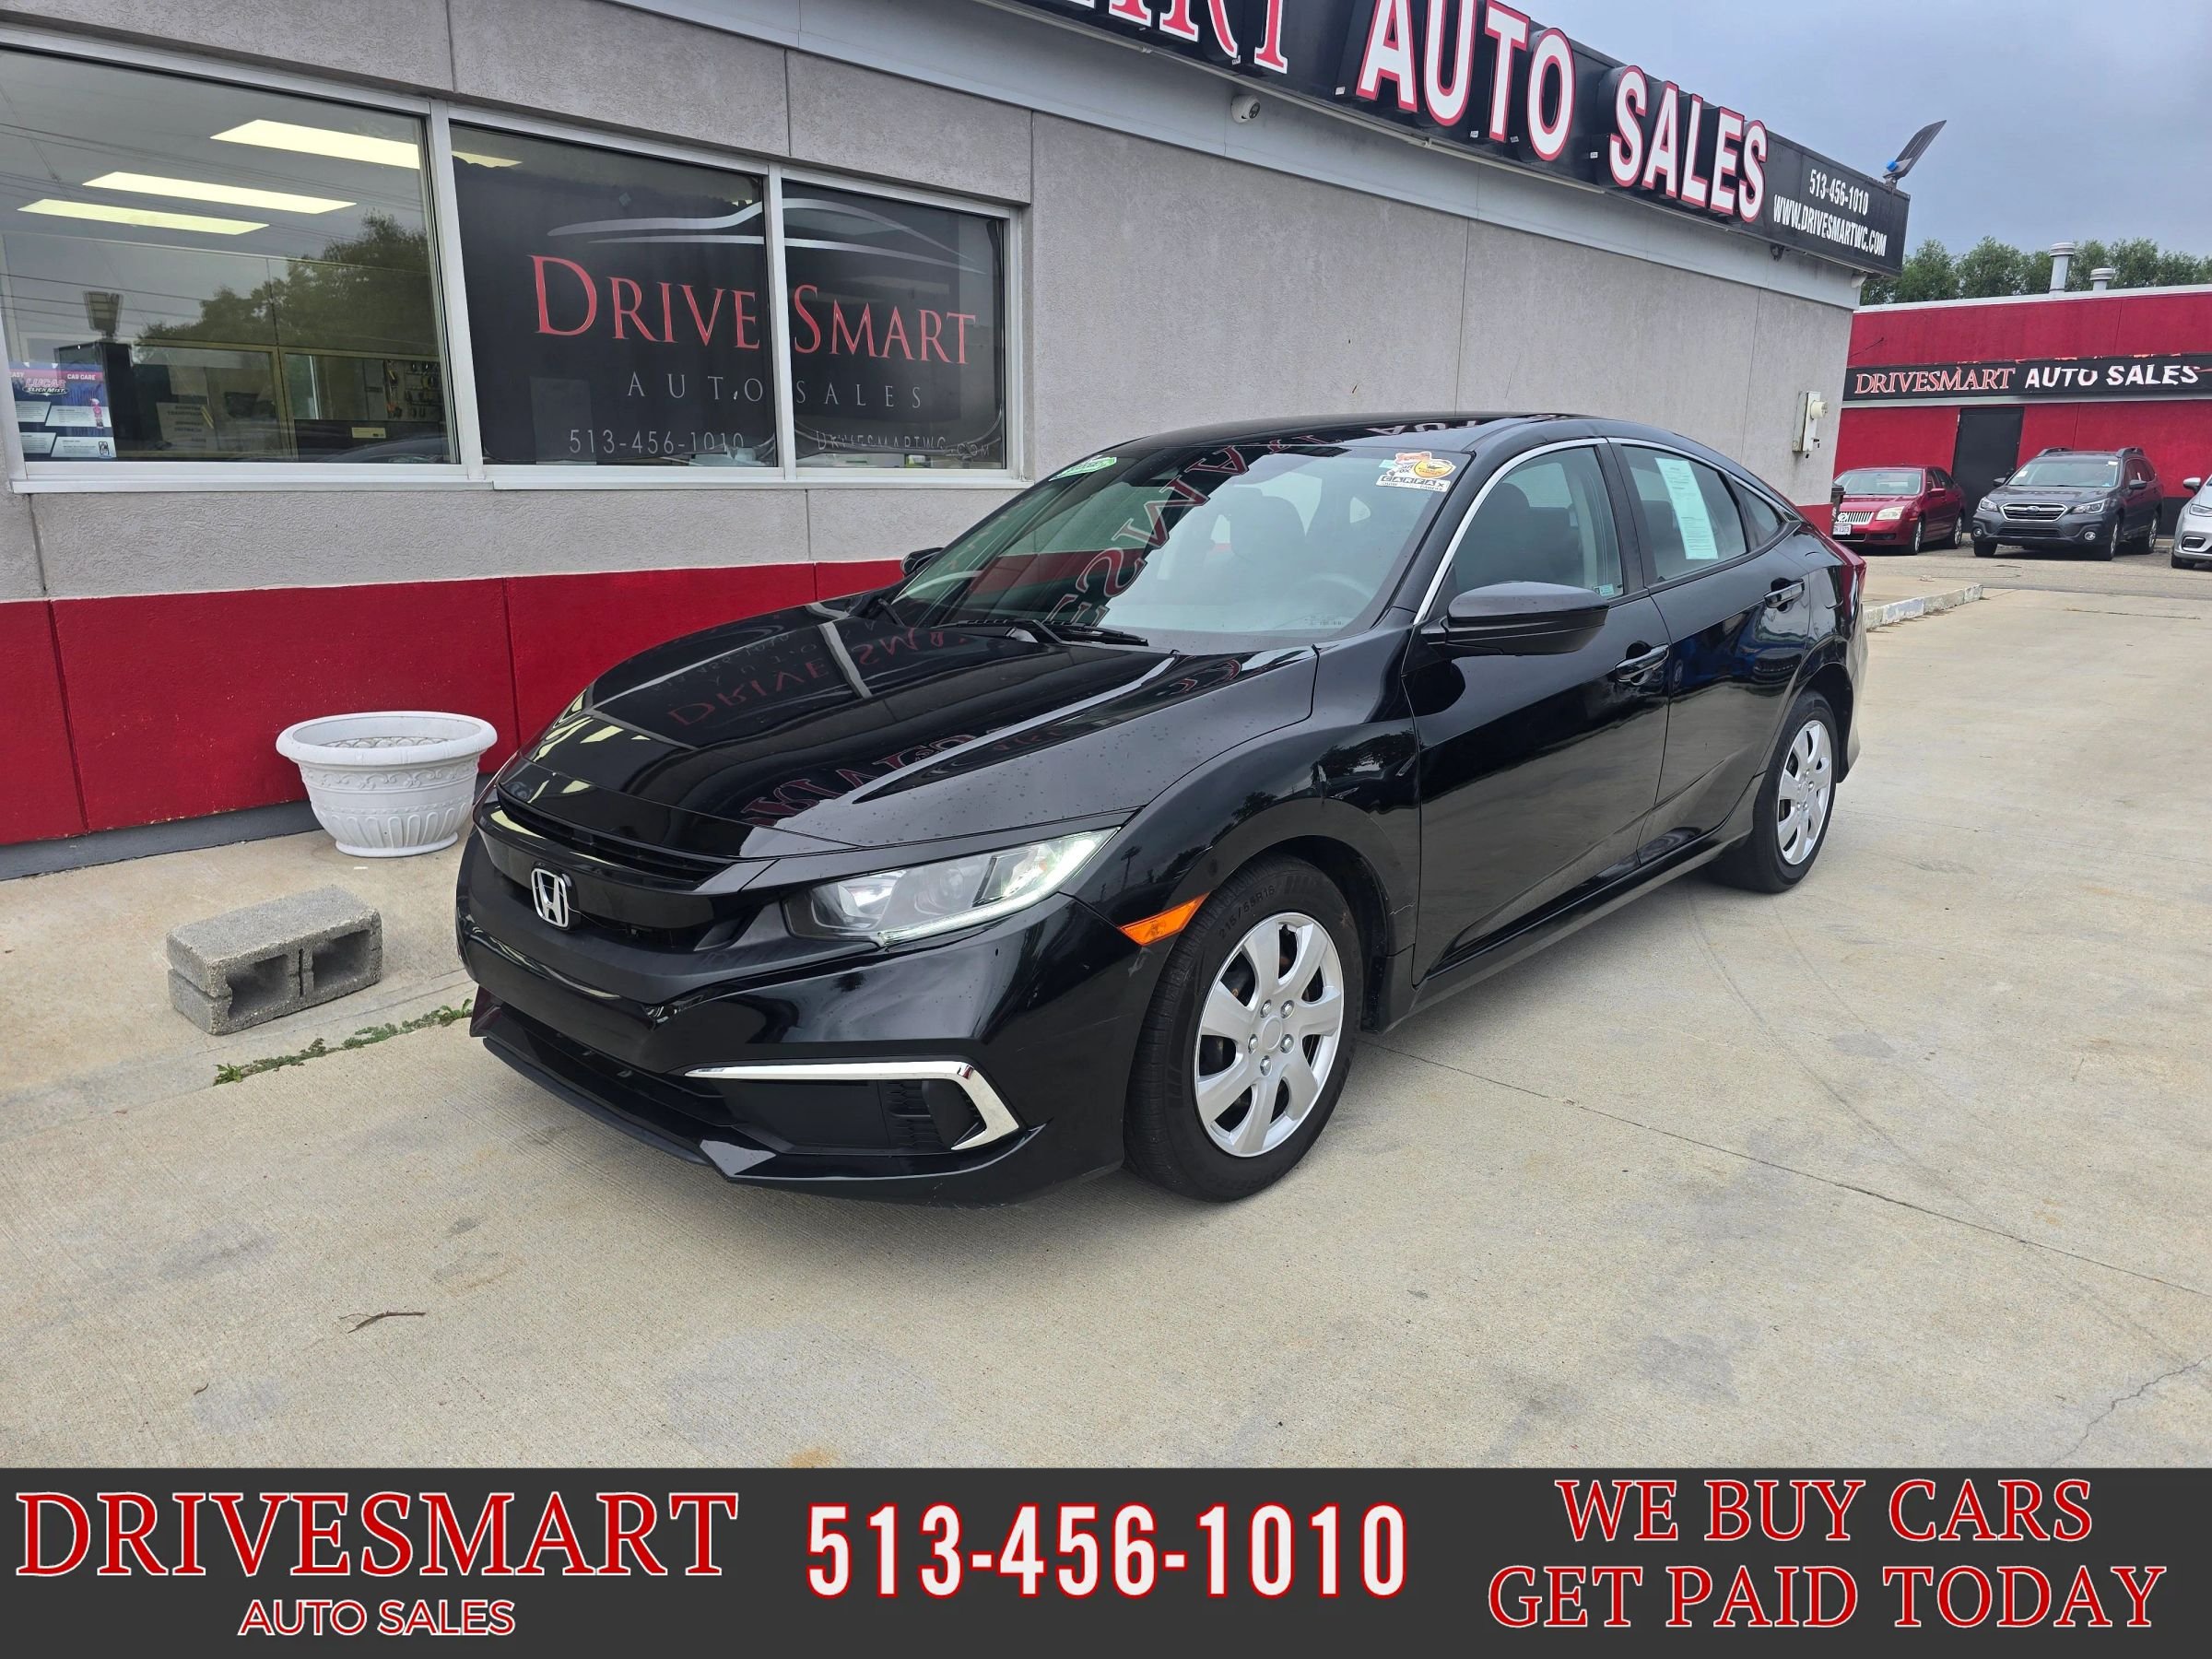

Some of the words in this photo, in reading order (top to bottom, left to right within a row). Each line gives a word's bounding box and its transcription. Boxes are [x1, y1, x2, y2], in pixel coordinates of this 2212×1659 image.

[1356, 0, 1576, 161] AUTO
[1609, 65, 1768, 222] SALES
[1810, 169, 1869, 216] 513-456-1010
[1773, 194, 1887, 256] WWW.DRIVESMARTWC.COM
[25, 378, 66, 388] LUCAS
[627, 371, 763, 403] AUTO
[795, 380, 921, 408] SALES
[1854, 367, 2016, 394] DRIVESMART
[2025, 367, 2098, 388] AUTO
[2105, 365, 2200, 386] SALES
[1382, 477, 1444, 488] CARFAX
